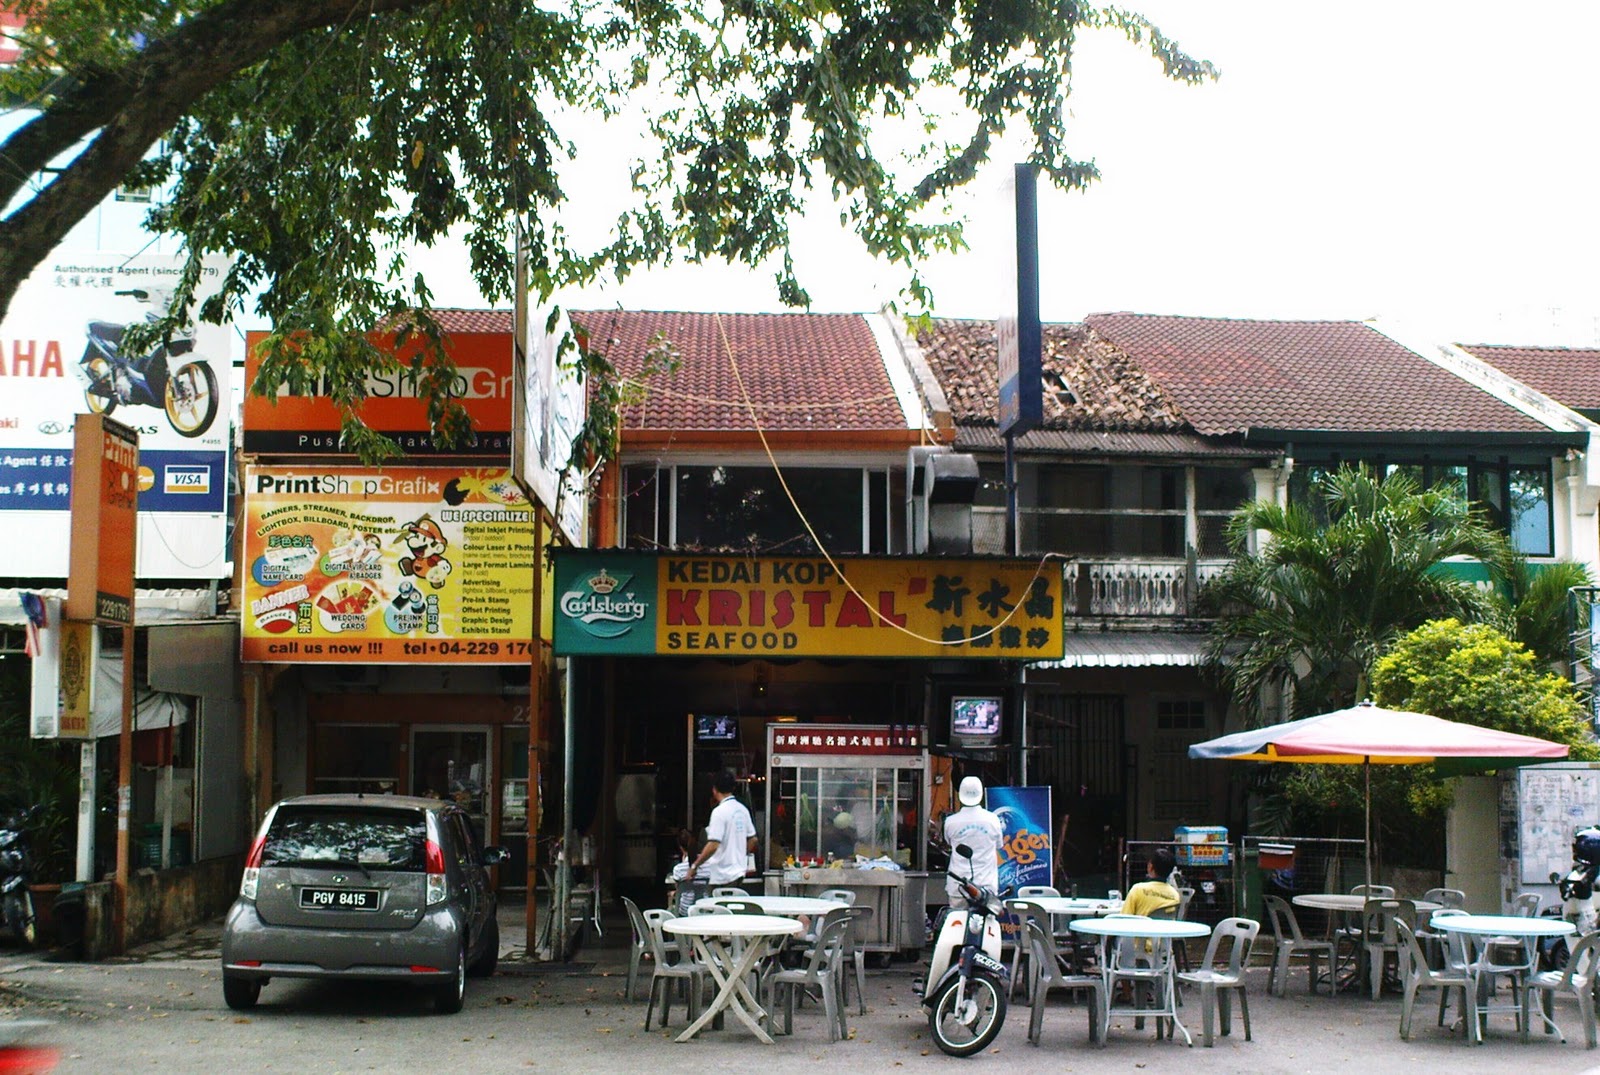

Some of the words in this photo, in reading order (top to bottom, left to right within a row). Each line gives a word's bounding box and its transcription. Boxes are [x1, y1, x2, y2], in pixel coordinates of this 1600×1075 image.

[54, 264, 113, 274] Authorised
[117, 266, 149, 276] Agent
[0, 339, 64, 377] HA
[4, 456, 37, 467] Agent
[175, 475, 200, 484] VISA
[441, 510, 460, 522] WE
[462, 510, 529, 522] SPECIALIZE
[352, 524, 383, 533] POSTER
[509, 527, 534, 535] Printing
[667, 561, 760, 584] KEDAI
[773, 562, 845, 585] KOPI
[463, 579, 501, 587] Advertising
[560, 591, 646, 623] Carlsberg
[666, 589, 907, 629] KRISTAL
[667, 632, 798, 649] SEAFOOD
[268, 642, 298, 654] call
[304, 644, 323, 654] us
[329, 644, 363, 654] now
[313, 892, 335, 904] PGV
[339, 893, 366, 906] 8415
